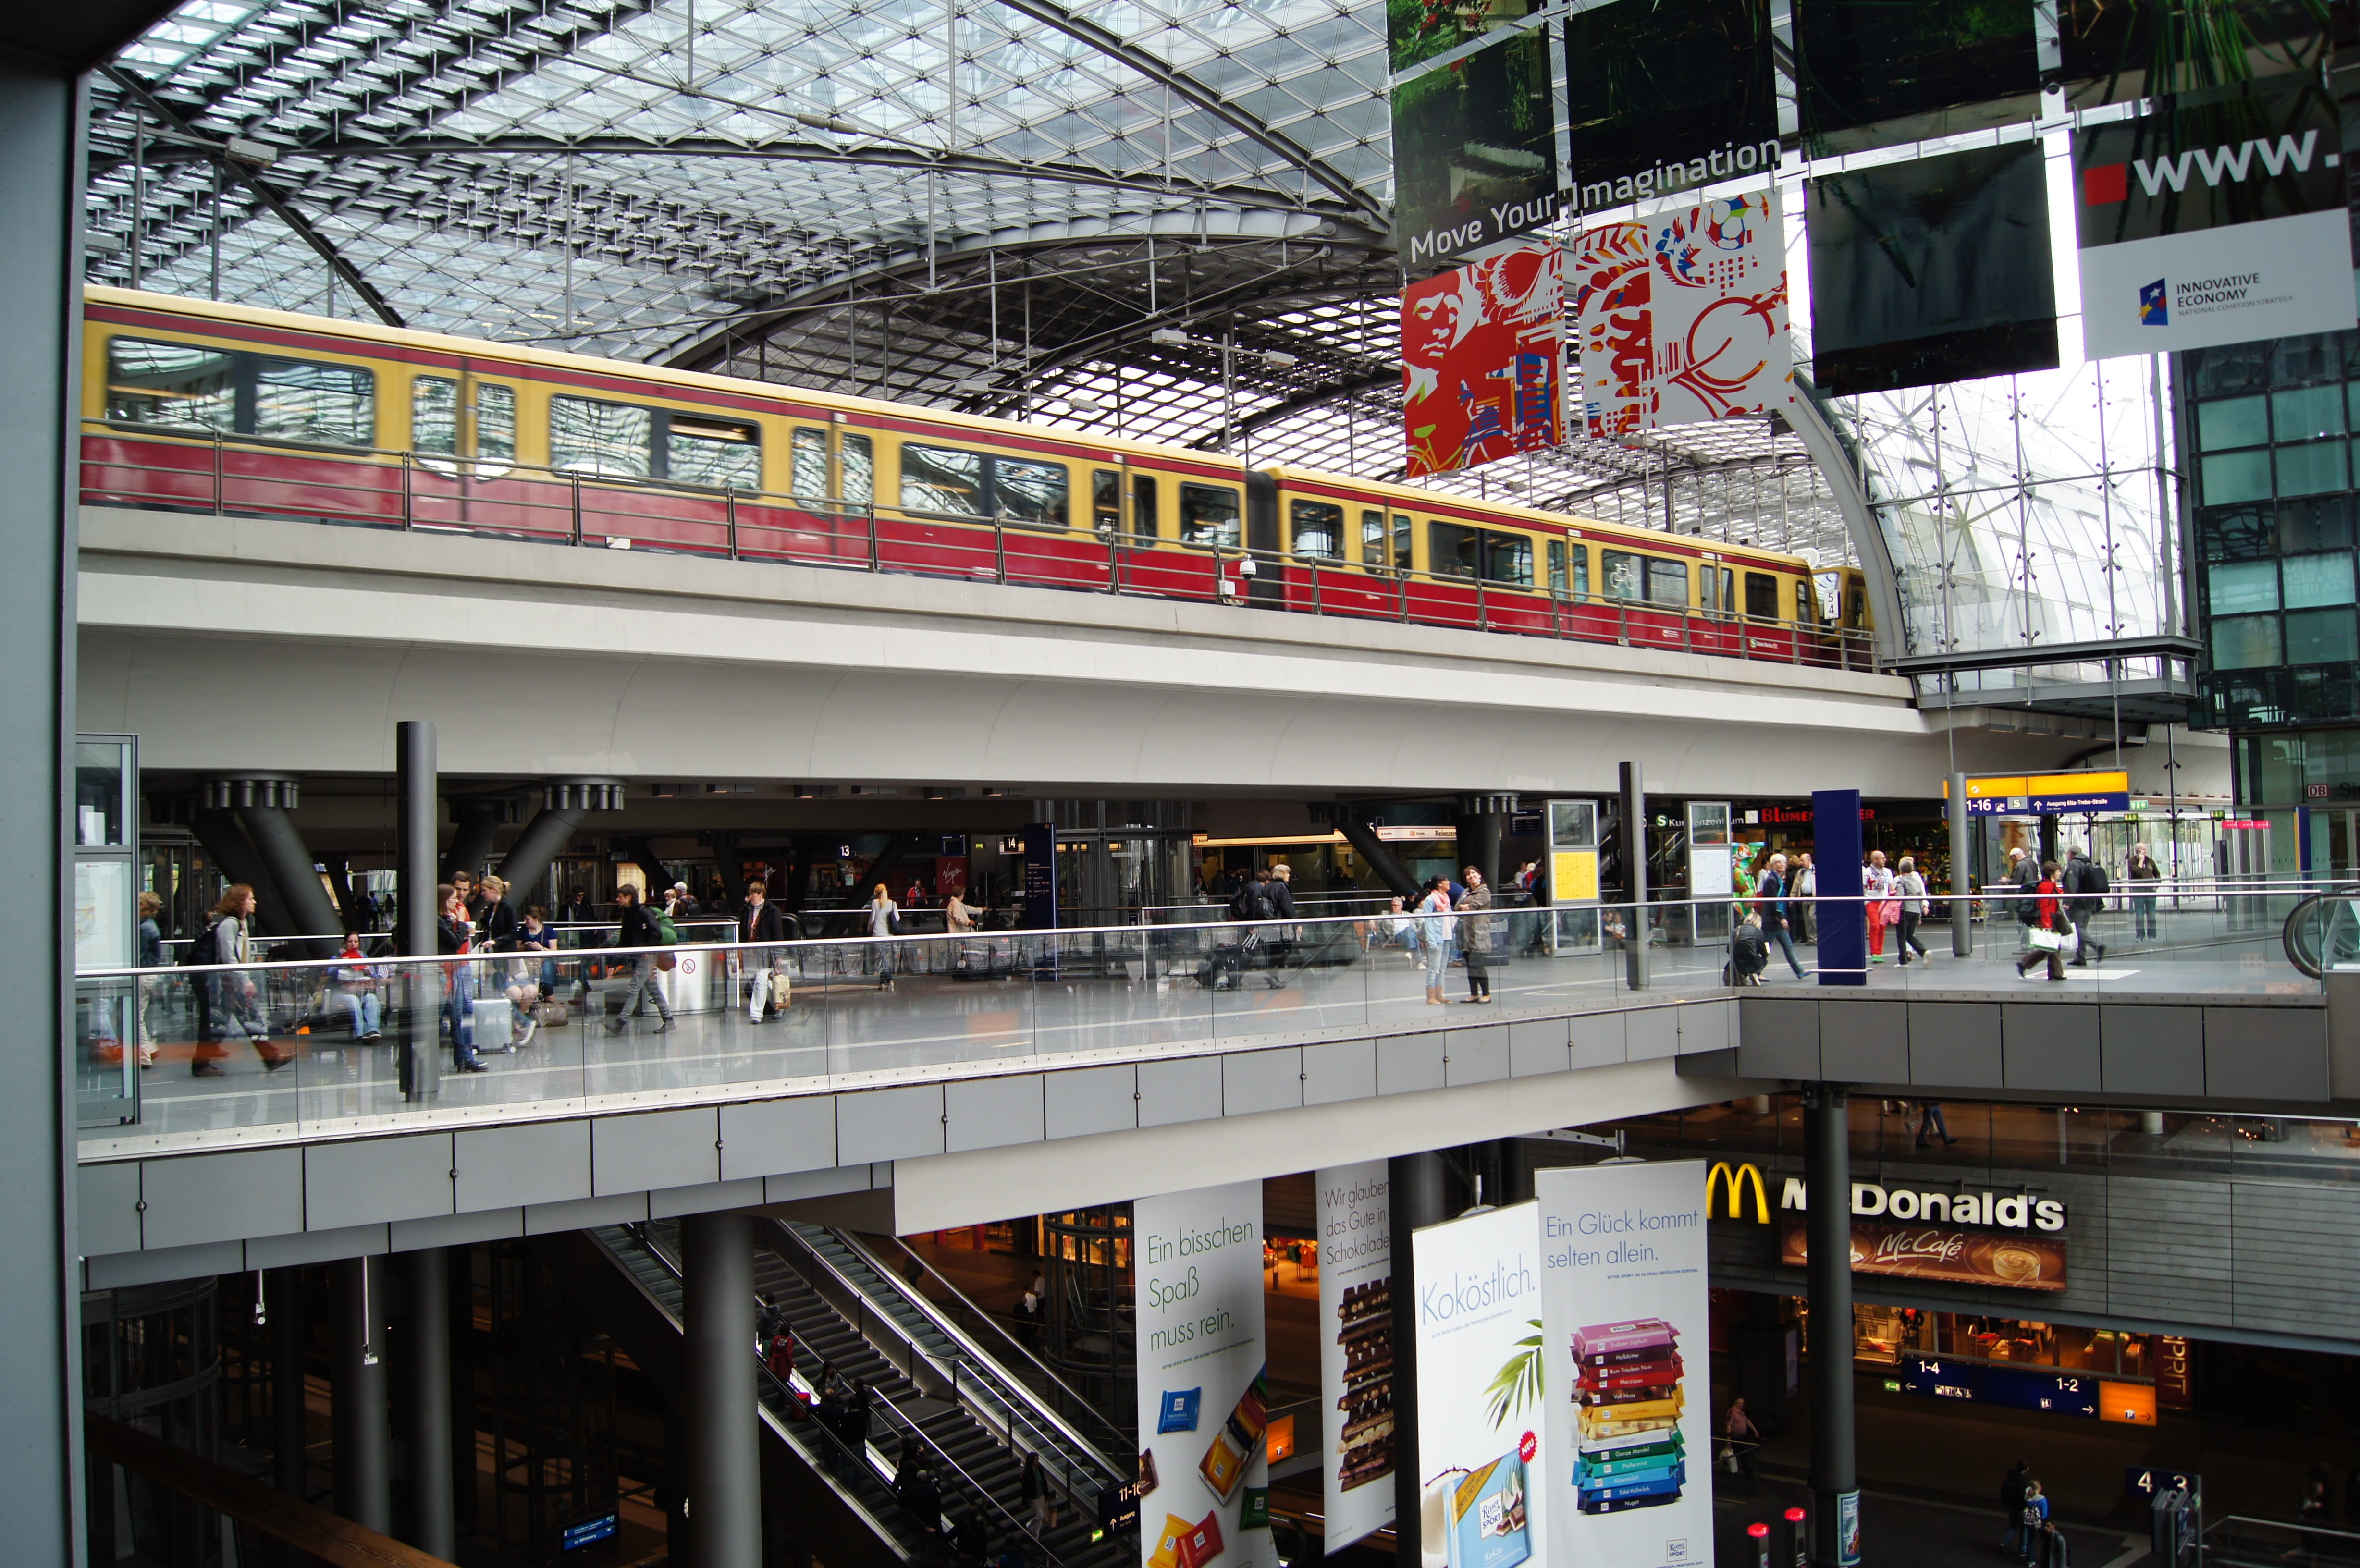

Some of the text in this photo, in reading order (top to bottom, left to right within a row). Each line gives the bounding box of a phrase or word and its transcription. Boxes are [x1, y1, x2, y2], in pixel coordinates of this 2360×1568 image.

[1411, 139, 1781, 263] Move Your Imagination
[2176, 273, 2260, 294] INNOVATIVE
[2177, 289, 2247, 307] ECONOMY
[2178, 295, 2293, 316] NATIONAL COHESION STRATEGY
[1828, 591, 1833, 602] 5
[1829, 604, 1834, 614] 4
[2309, 786, 2327, 796] DB
[2013, 799, 2020, 808] S
[840, 845, 850, 856] 13
[1007, 836, 1016, 848] 14
[943, 863, 962, 884] Virgin
[1325, 1188, 1345, 1208] Wir
[1781, 1177, 2064, 1231] MDonald's
[1326, 1207, 1386, 1237] das Gute in
[1547, 1209, 1698, 1237] Ein Glück kommt
[1148, 1216, 1252, 1264] Ein bisschen
[1327, 1230, 1389, 1265] Schokolade
[1548, 1240, 1658, 1268] selten allein.
[1149, 1266, 1199, 1314] Spaß
[1423, 1253, 1535, 1325] Koköstlich.
[1151, 1308, 1234, 1351] muss rein.
[1919, 1360, 1940, 1374] 1-4
[2056, 1377, 2078, 1392] 1-2
[1521, 1438, 1534, 1456] NEU
[2137, 1470, 2153, 1492] 4
[1120, 1511, 1135, 1521] Ausgang
[1481, 1499, 1500, 1519] Ritter
[1482, 1513, 1501, 1529] SPORT
[1485, 1546, 1502, 1562] Kokos
[1669, 1543, 1685, 1551] Ritter
